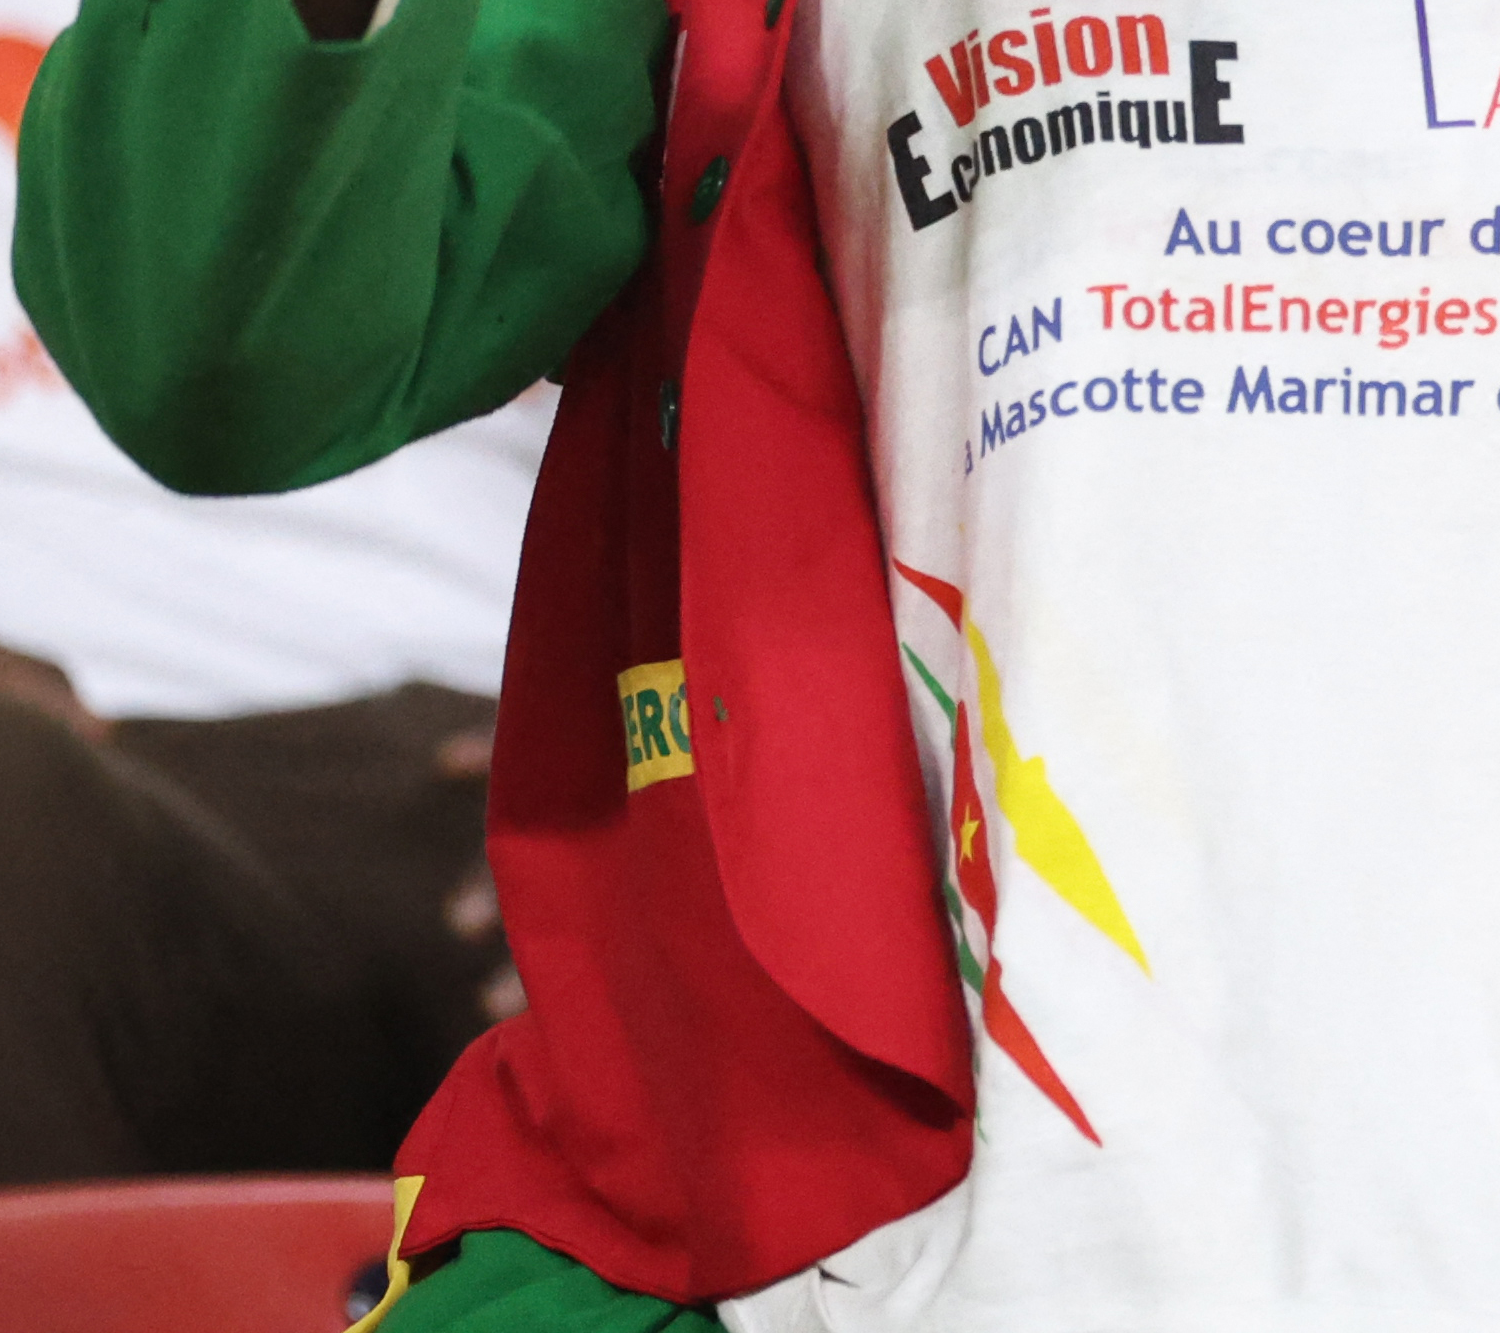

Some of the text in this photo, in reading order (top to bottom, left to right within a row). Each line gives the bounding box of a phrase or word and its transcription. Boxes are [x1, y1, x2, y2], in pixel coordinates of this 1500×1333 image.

[924, 7, 1170, 128] Vision
[1164, 207, 1241, 255] Au
[1267, 217, 1445, 257] coeur
[978, 297, 1062, 377] CAN
[1086, 283, 1499, 350] TotalEnergies
[980, 368, 1205, 459] Mascotte
[1226, 365, 1475, 417] Marimar
